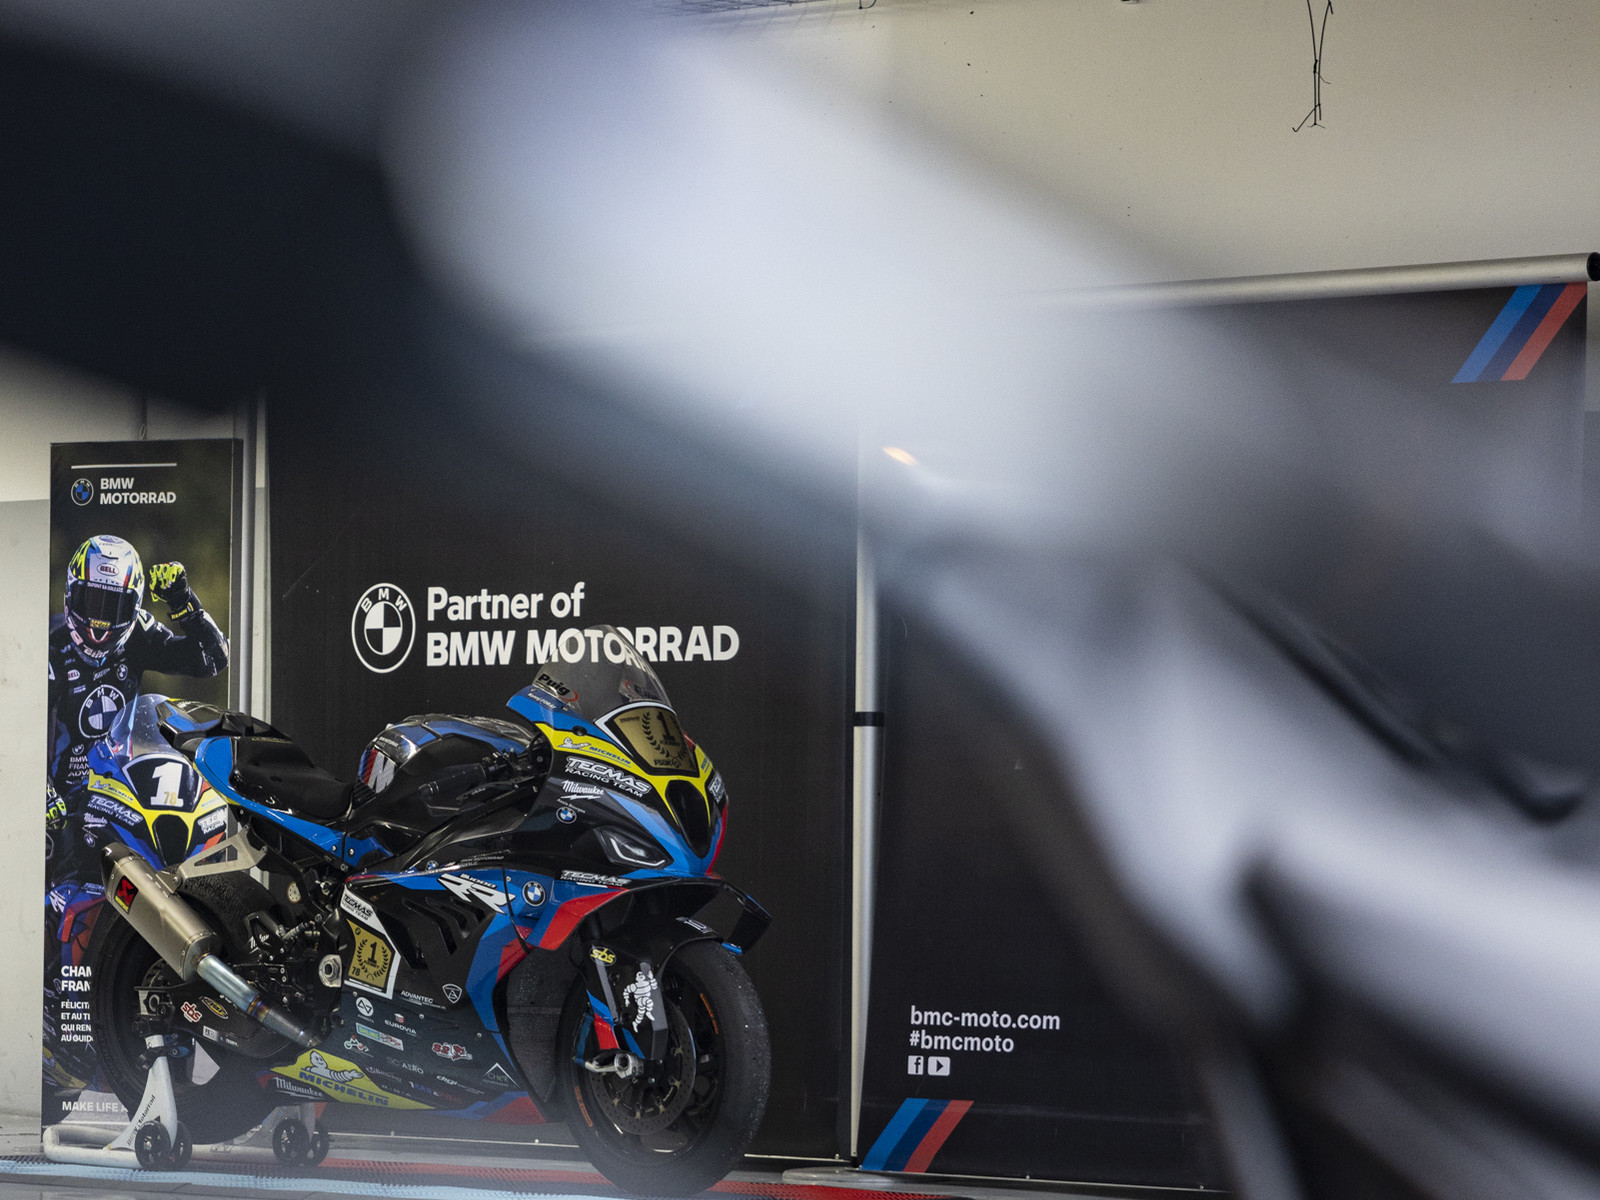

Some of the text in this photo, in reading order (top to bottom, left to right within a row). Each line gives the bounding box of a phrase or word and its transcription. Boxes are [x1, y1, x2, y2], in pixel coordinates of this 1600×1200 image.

[100, 477, 134, 490] BMW
[100, 491, 177, 505] MOTORRAD
[100, 565, 116, 575] BELL
[360, 588, 407, 613] BMW
[427, 582, 585, 621] Partner of
[426, 625, 740, 667] BMW MOTORRAD
[538, 673, 570, 696] Puig
[589, 746, 631, 765] MICHELIN
[565, 768, 643, 798] RACING TEAM
[567, 757, 651, 793] TECMAS
[150, 761, 184, 807] 1
[561, 780, 605, 795] Milwaukee
[164, 791, 177, 805] 78
[91, 795, 142, 822] TECMAS
[115, 813, 135, 827] TEAM
[561, 869, 631, 885] TECMAS
[344, 893, 373, 918] TECMAS
[367, 941, 378, 964] 1
[590, 948, 615, 963] sbs
[351, 965, 361, 977] 78
[400, 990, 434, 1004] ADVANTEC
[61, 1012, 71, 1020] ET
[71, 1012, 83, 1020] AU
[182, 1003, 201, 1021] sbs
[910, 1005, 1060, 1029] bmc-moto.com
[61, 1023, 75, 1032] QUI
[384, 1020, 417, 1035] EUROVIA
[61, 1034, 93, 1042] AU GUID
[909, 1030, 1014, 1052] #bmcmoto
[299, 1071, 388, 1105] MICHELIN
[62, 1101, 94, 1111] MAKE
[96, 1102, 119, 1112] LIFE
